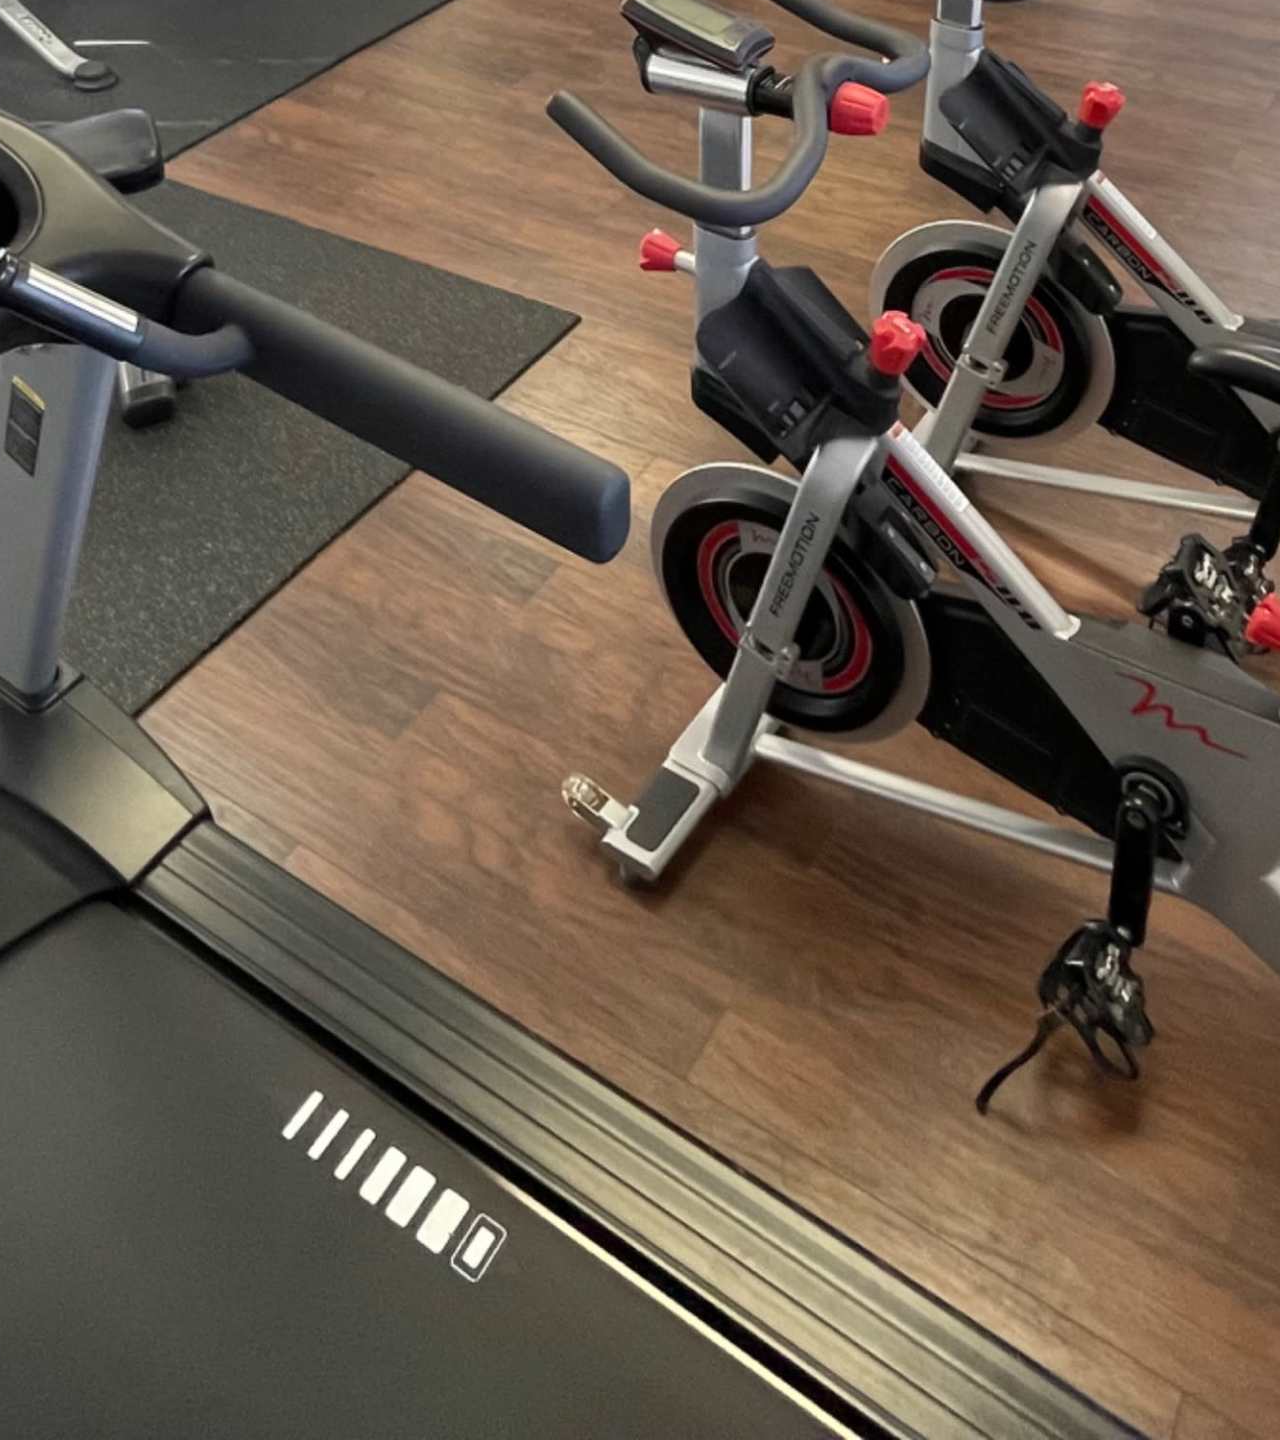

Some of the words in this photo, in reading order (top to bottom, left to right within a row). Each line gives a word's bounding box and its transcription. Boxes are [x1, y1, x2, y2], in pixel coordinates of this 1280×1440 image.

[985, 240, 1038, 336] FREEMOTION
[1086, 212, 1152, 280] CARBON
[768, 510, 821, 618] FREEMOTION
[886, 476, 966, 566] CARBON
